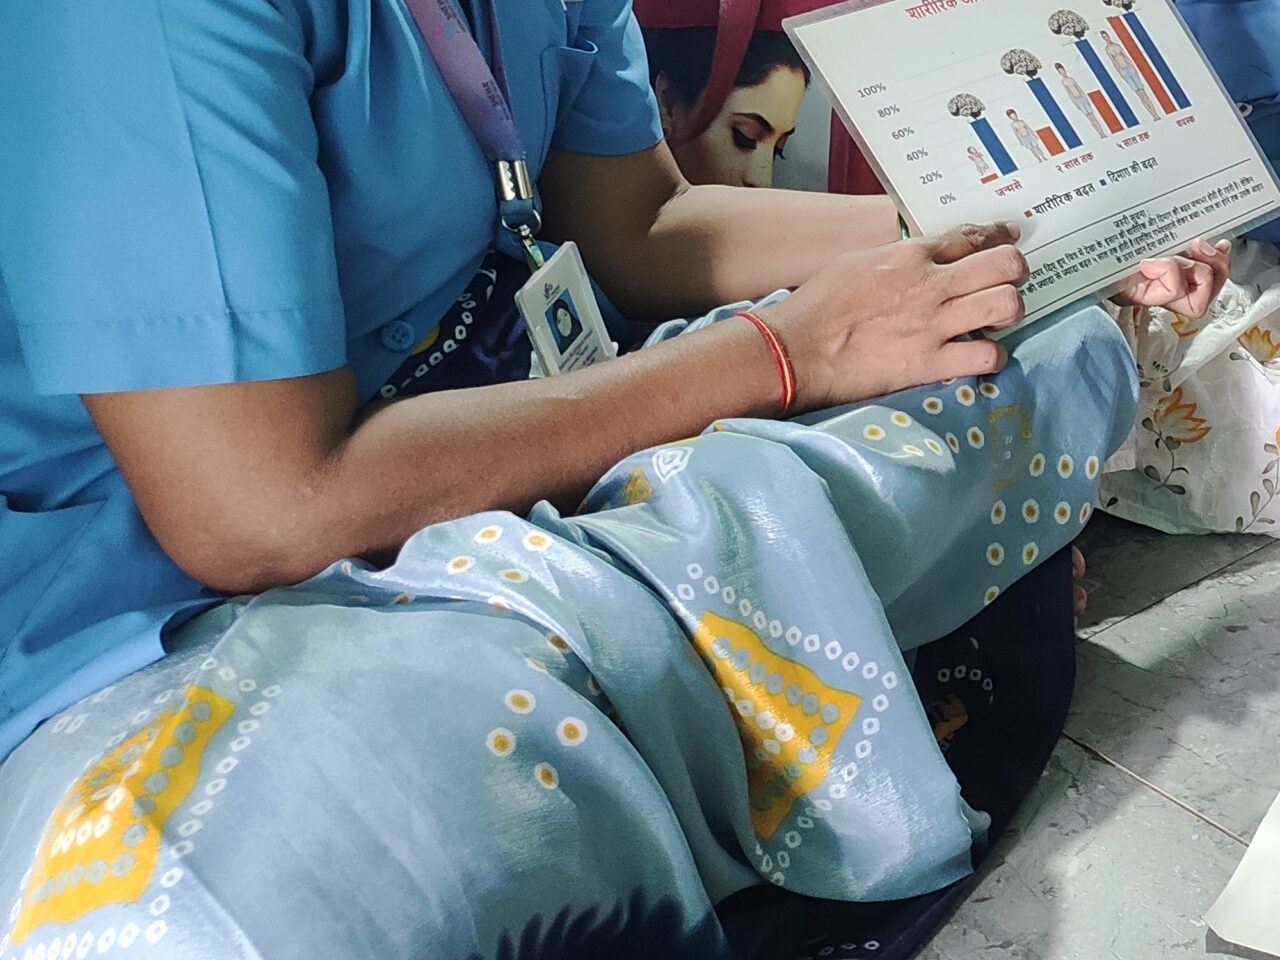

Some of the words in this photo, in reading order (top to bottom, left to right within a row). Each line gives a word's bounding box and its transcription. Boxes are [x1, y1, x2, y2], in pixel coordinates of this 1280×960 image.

[857, 82, 886, 97] 100%
[877, 104, 900, 118] 80%
[891, 126, 914, 140] 60%
[1122, 136, 1138, 146] साल
[1137, 131, 1150, 141] तक
[906, 148, 928, 161] 40%
[1055, 164, 1064, 173] २
[1062, 157, 1080, 169] साल
[1079, 152, 1093, 162] तक
[1129, 160, 1142, 173] की
[919, 170, 942, 184] 20%
[939, 192, 956, 205] 0%
[1032, 191, 1073, 213] शारीरिक
[1042, 262, 1058, 272] दिए
